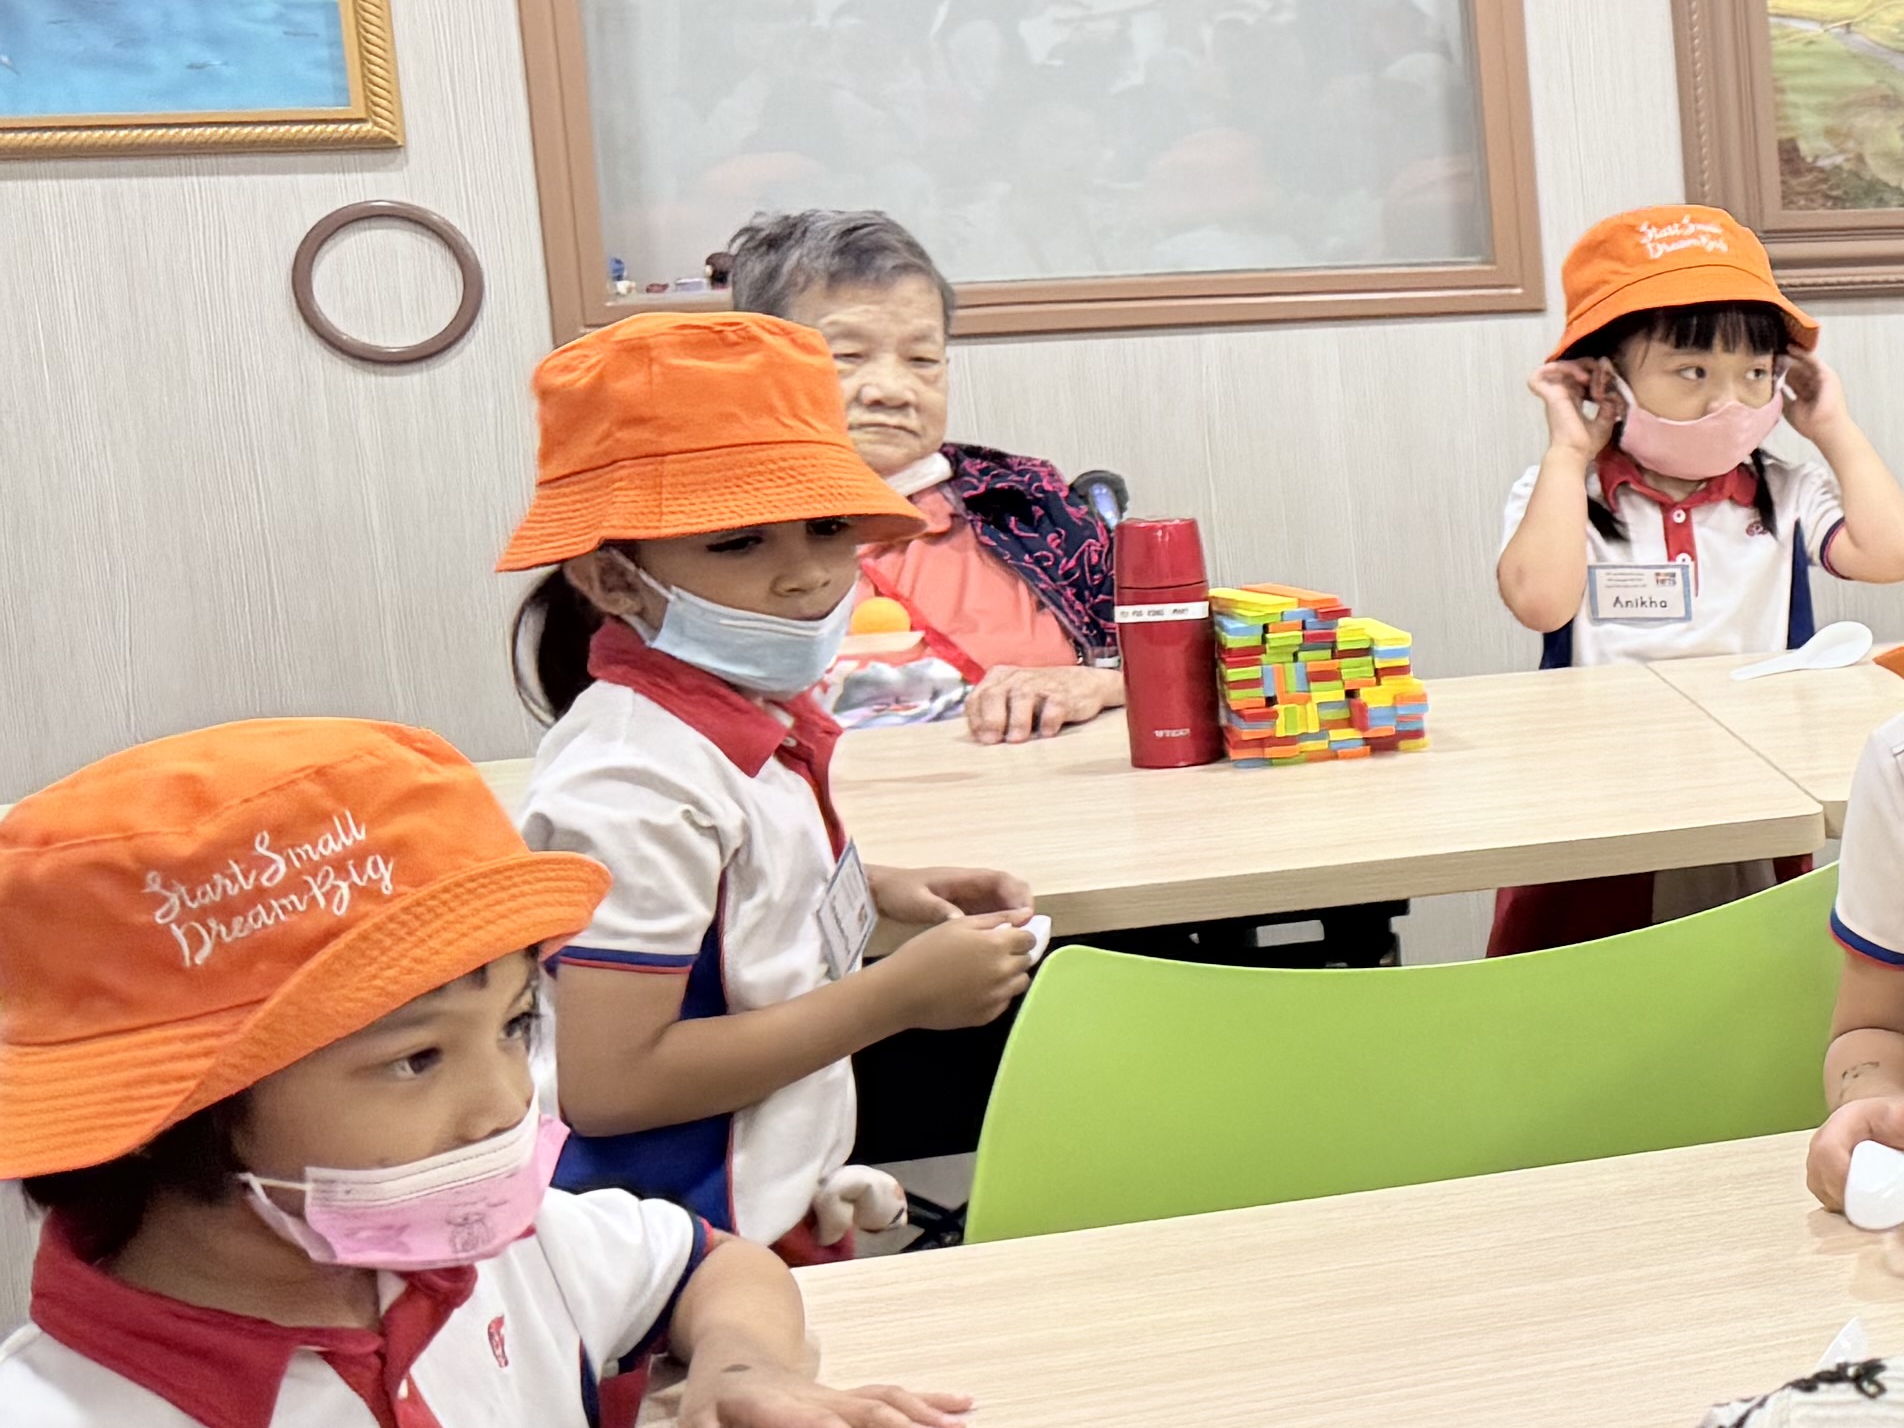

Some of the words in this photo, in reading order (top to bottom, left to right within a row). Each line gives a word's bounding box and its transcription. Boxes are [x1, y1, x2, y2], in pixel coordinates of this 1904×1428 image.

[1612, 595, 1668, 609] Anikha
[141, 859, 256, 924] Start
[254, 810, 366, 887] Small
[170, 893, 310, 968] Dream
[302, 854, 395, 917] Big
